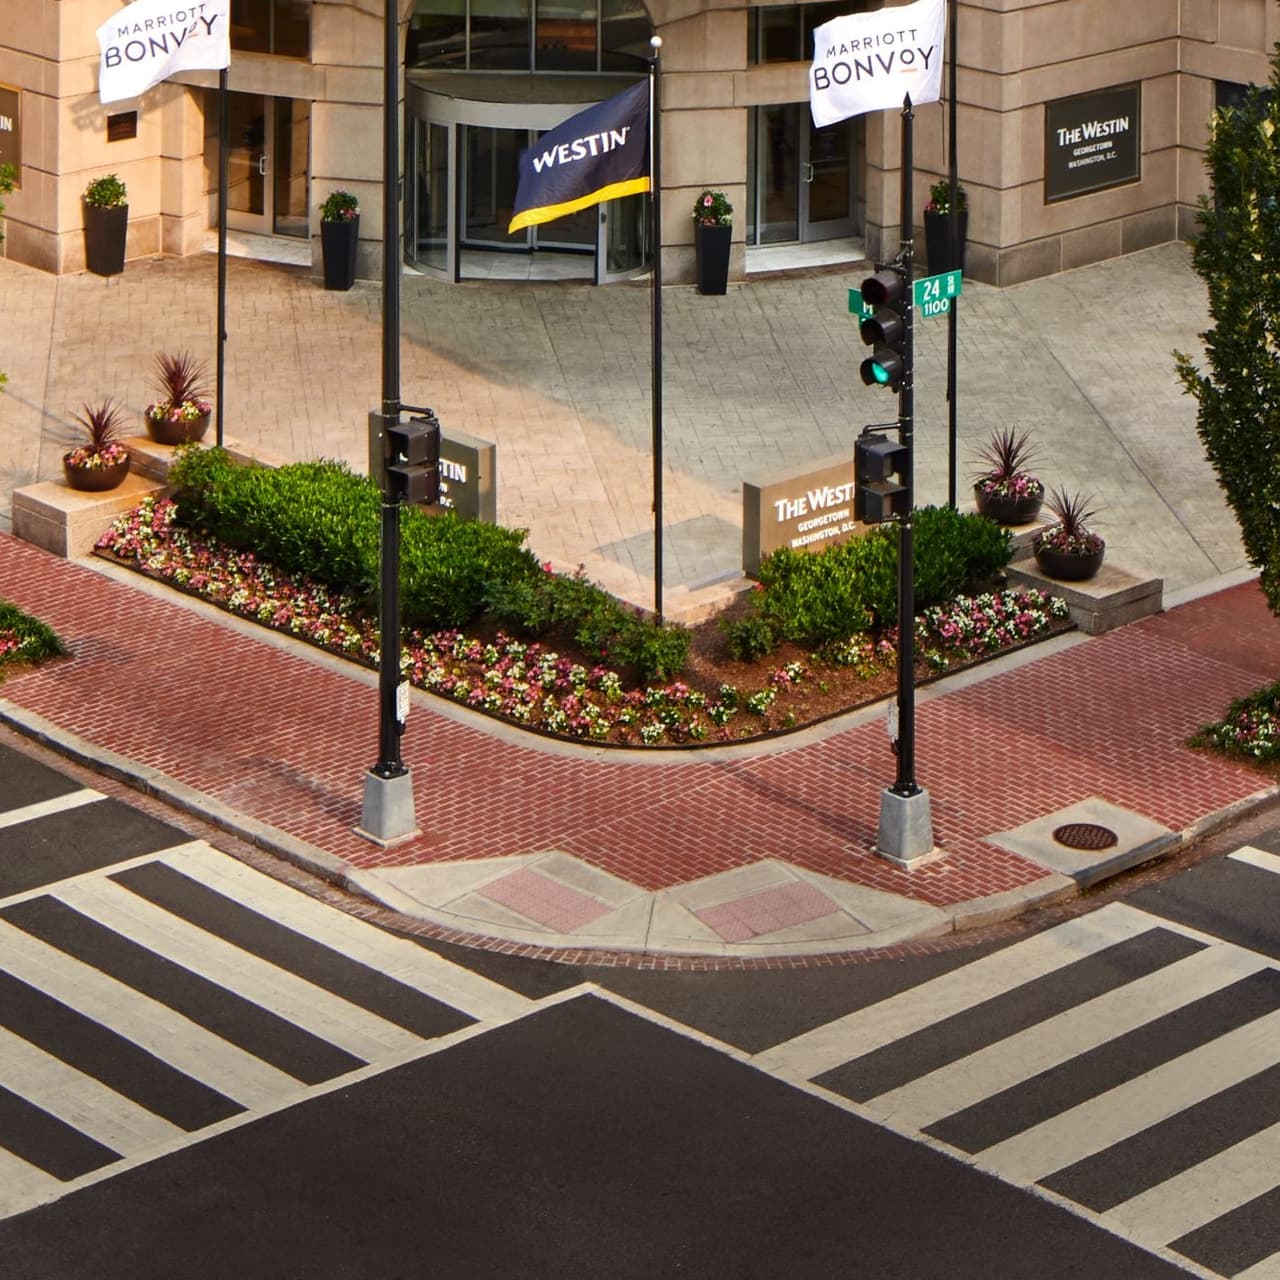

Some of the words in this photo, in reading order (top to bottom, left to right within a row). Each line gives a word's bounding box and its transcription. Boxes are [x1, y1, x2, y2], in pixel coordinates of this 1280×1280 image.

[117, 3, 206, 38] MARRIOTT
[826, 29, 917, 58] MARRIOTT
[814, 45, 934, 90] BONVOY
[1057, 127, 1082, 146] THE
[1082, 117, 1129, 140] WESTIN
[532, 127, 628, 173] WESTIN
[923, 279, 940, 301] 24
[925, 298, 948, 316] 1100
[775, 499, 808, 522] THE
[798, 508, 850, 532] GEORGETOWN
